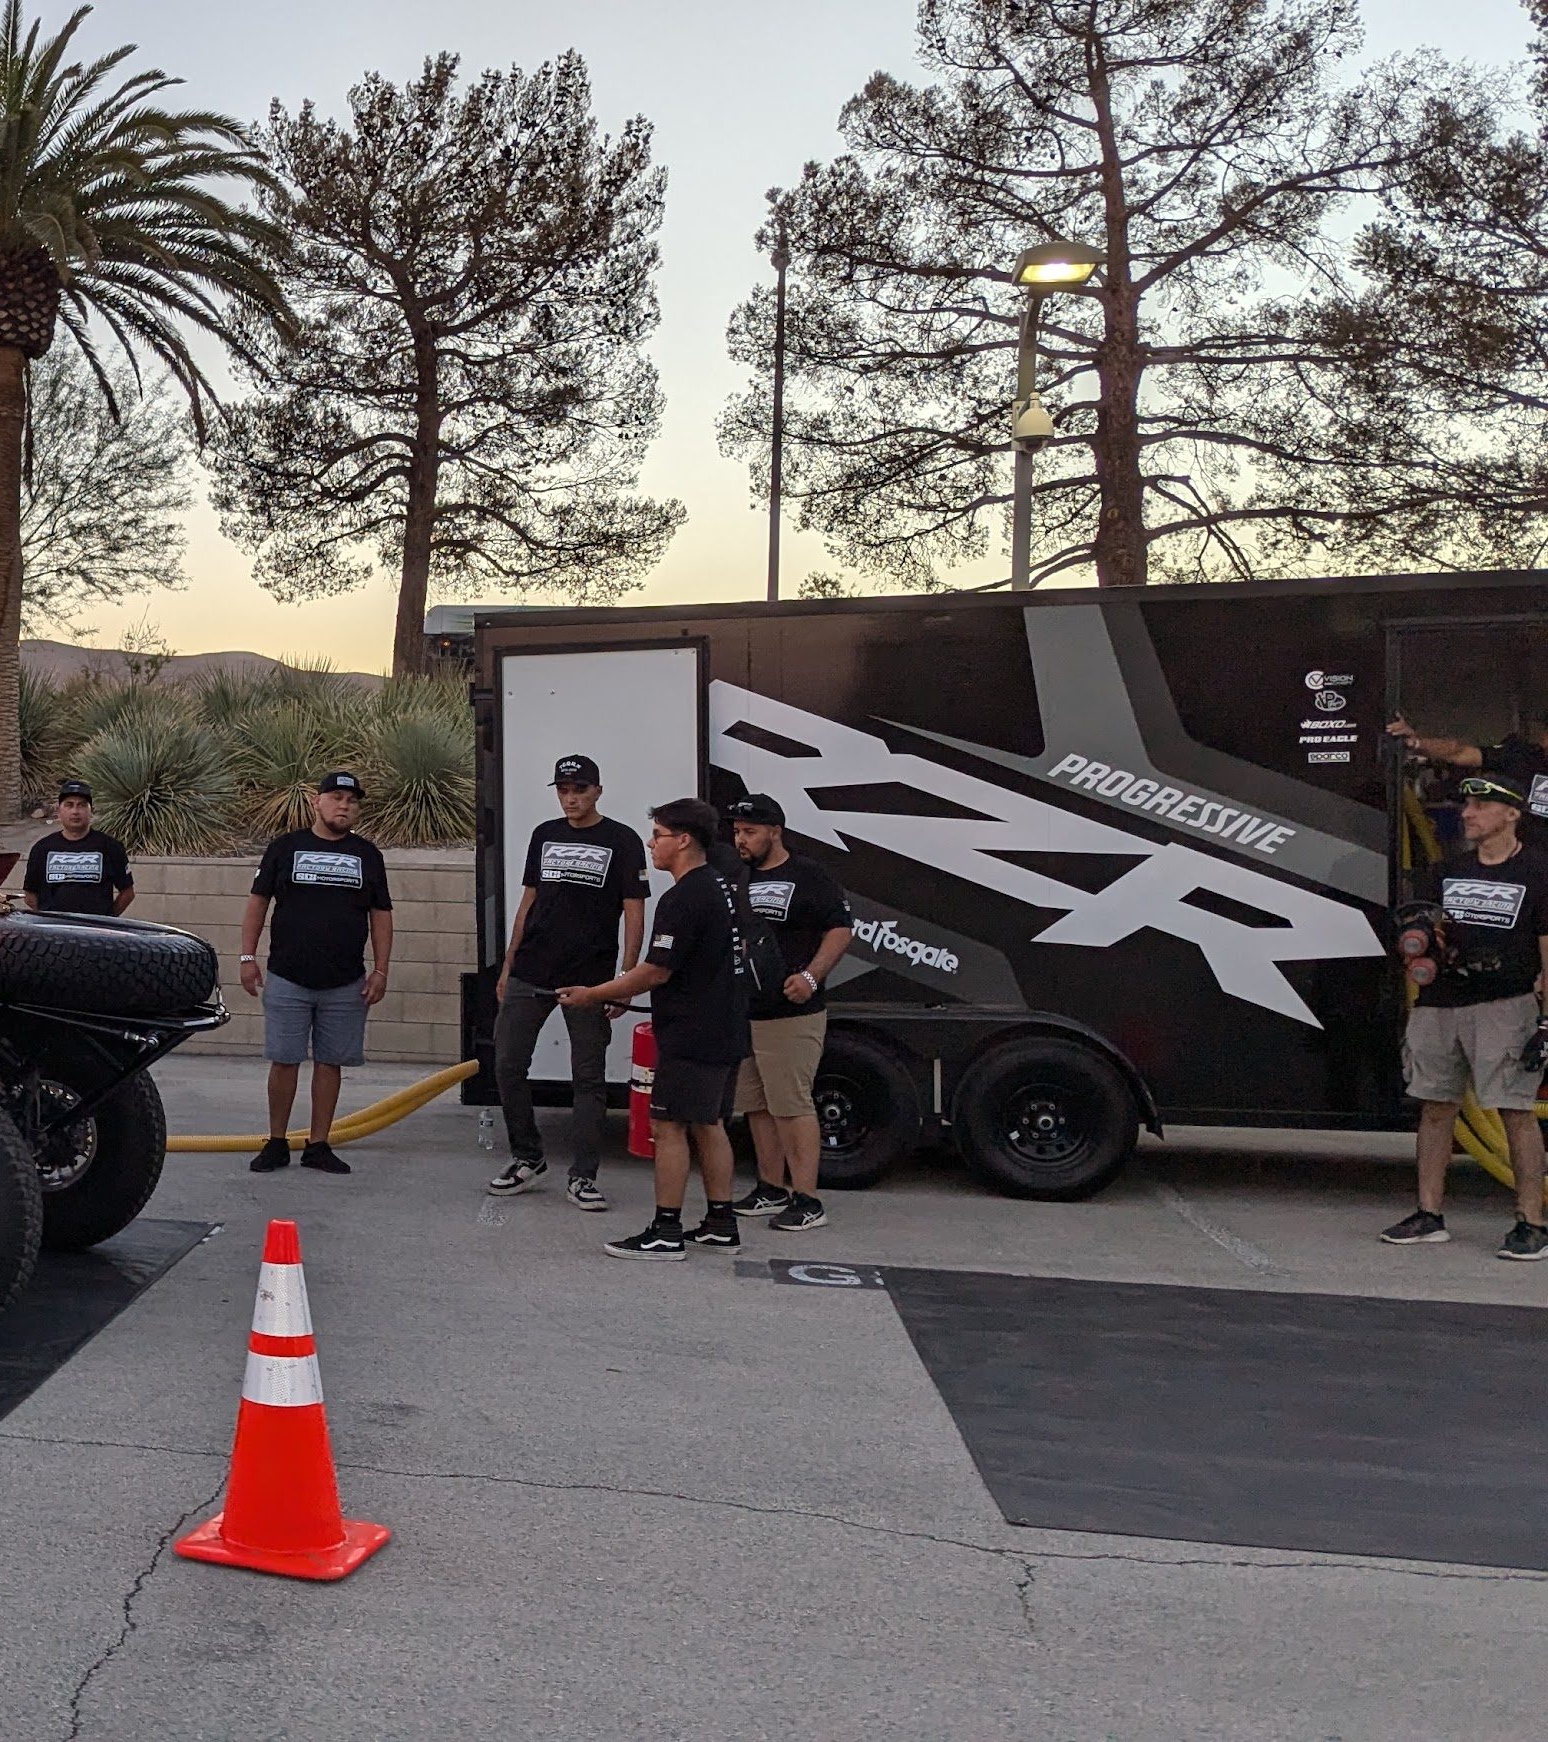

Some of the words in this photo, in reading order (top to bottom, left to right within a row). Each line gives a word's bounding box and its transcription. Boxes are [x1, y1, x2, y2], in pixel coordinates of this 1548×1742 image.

[1299, 736, 1322, 744] PRO
[1323, 735, 1358, 743] EAGLE
[1047, 753, 1296, 854] PROGRESSIVE
[49, 854, 100, 865] RZR
[298, 854, 358, 868] RZR
[544, 845, 607, 862] RZR
[709, 679, 1386, 1031] RZR
[748, 884, 790, 896] ZR
[1444, 883, 1519, 900] RZR
